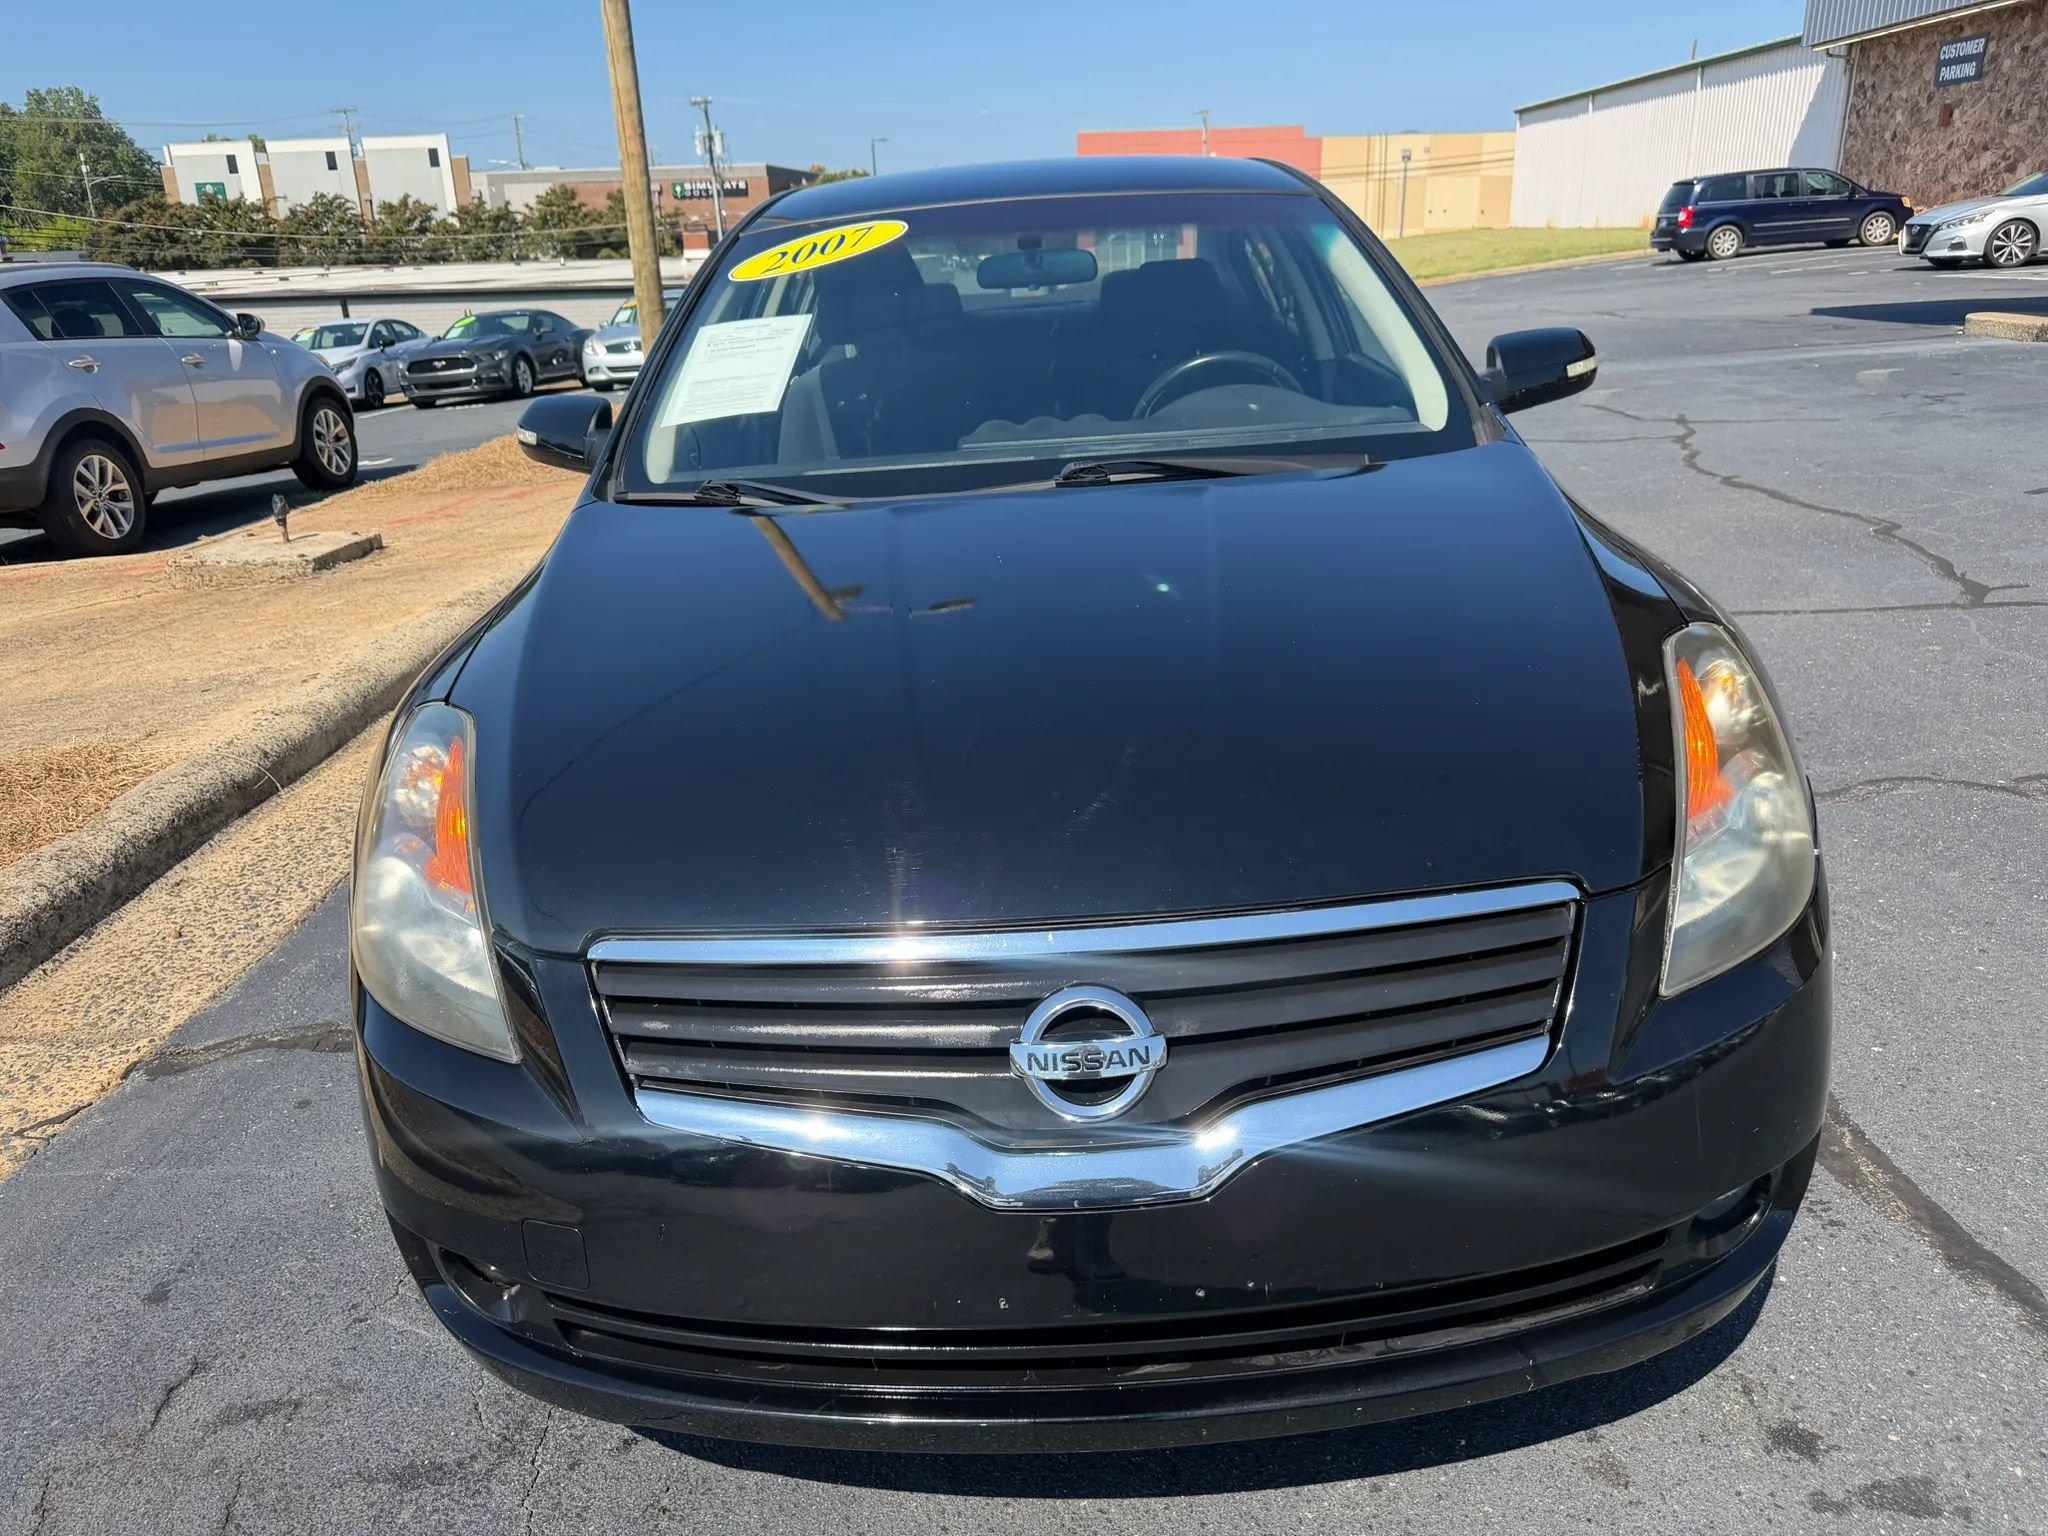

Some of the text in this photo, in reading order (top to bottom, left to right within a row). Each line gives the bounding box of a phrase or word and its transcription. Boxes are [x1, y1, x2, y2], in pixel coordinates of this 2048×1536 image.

[1940, 37, 1985, 60] CUSTOMER
[1939, 61, 1976, 82] PARKING
[683, 180, 746, 190] SIMUATE
[760, 225, 875, 274] 2007
[1027, 1045, 1150, 1072] NISSAN
